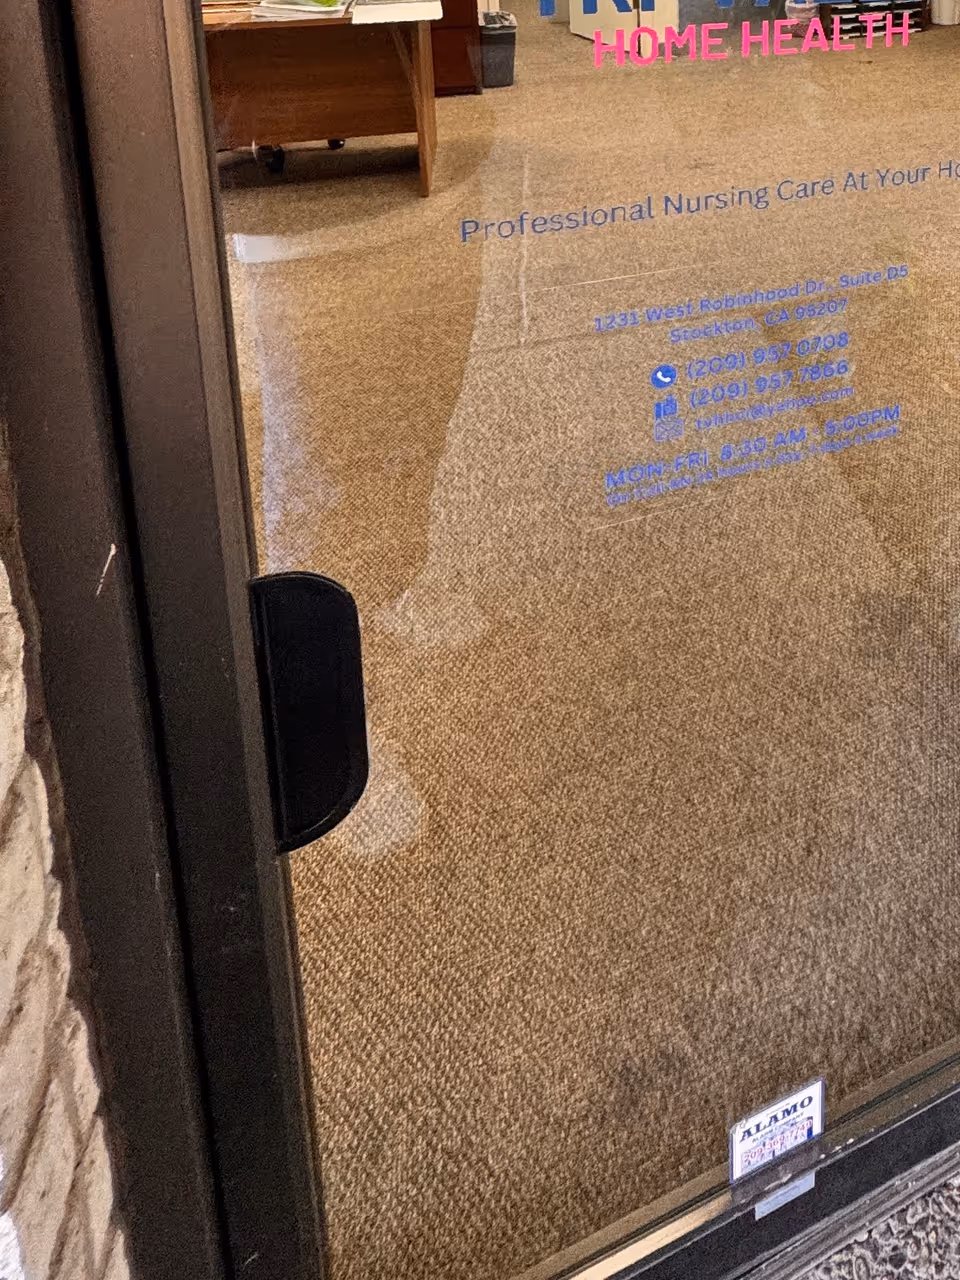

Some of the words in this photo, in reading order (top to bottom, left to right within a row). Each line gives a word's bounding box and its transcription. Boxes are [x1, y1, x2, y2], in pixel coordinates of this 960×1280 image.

[594, 22, 728, 67] HOME
[741, 13, 909, 57] HEALTH
[461, 195, 654, 242] Professional
[664, 185, 769, 216] Nursing
[777, 180, 834, 200] Care
[843, 171, 868, 192] At
[876, 167, 930, 187] Your
[594, 311, 639, 331] 1231
[646, 302, 693, 321] West
[699, 287, 799, 312] Robinhood
[839, 272, 882, 288] Suite
[887, 265, 909, 280] D5
[765, 309, 790, 326] CA
[795, 298, 847, 320] 95207
[687, 351, 746, 379] (209)
[753, 342, 791, 365] 957
[797, 331, 849, 356] 0708
[690, 380, 748, 409] (209)
[754, 371, 793, 394] 957
[800, 359, 849, 383] 7866
[606, 450, 709, 490] MON-FRI
[773, 426, 806, 448] AM
[740, 1096, 814, 1143] ALAMO
